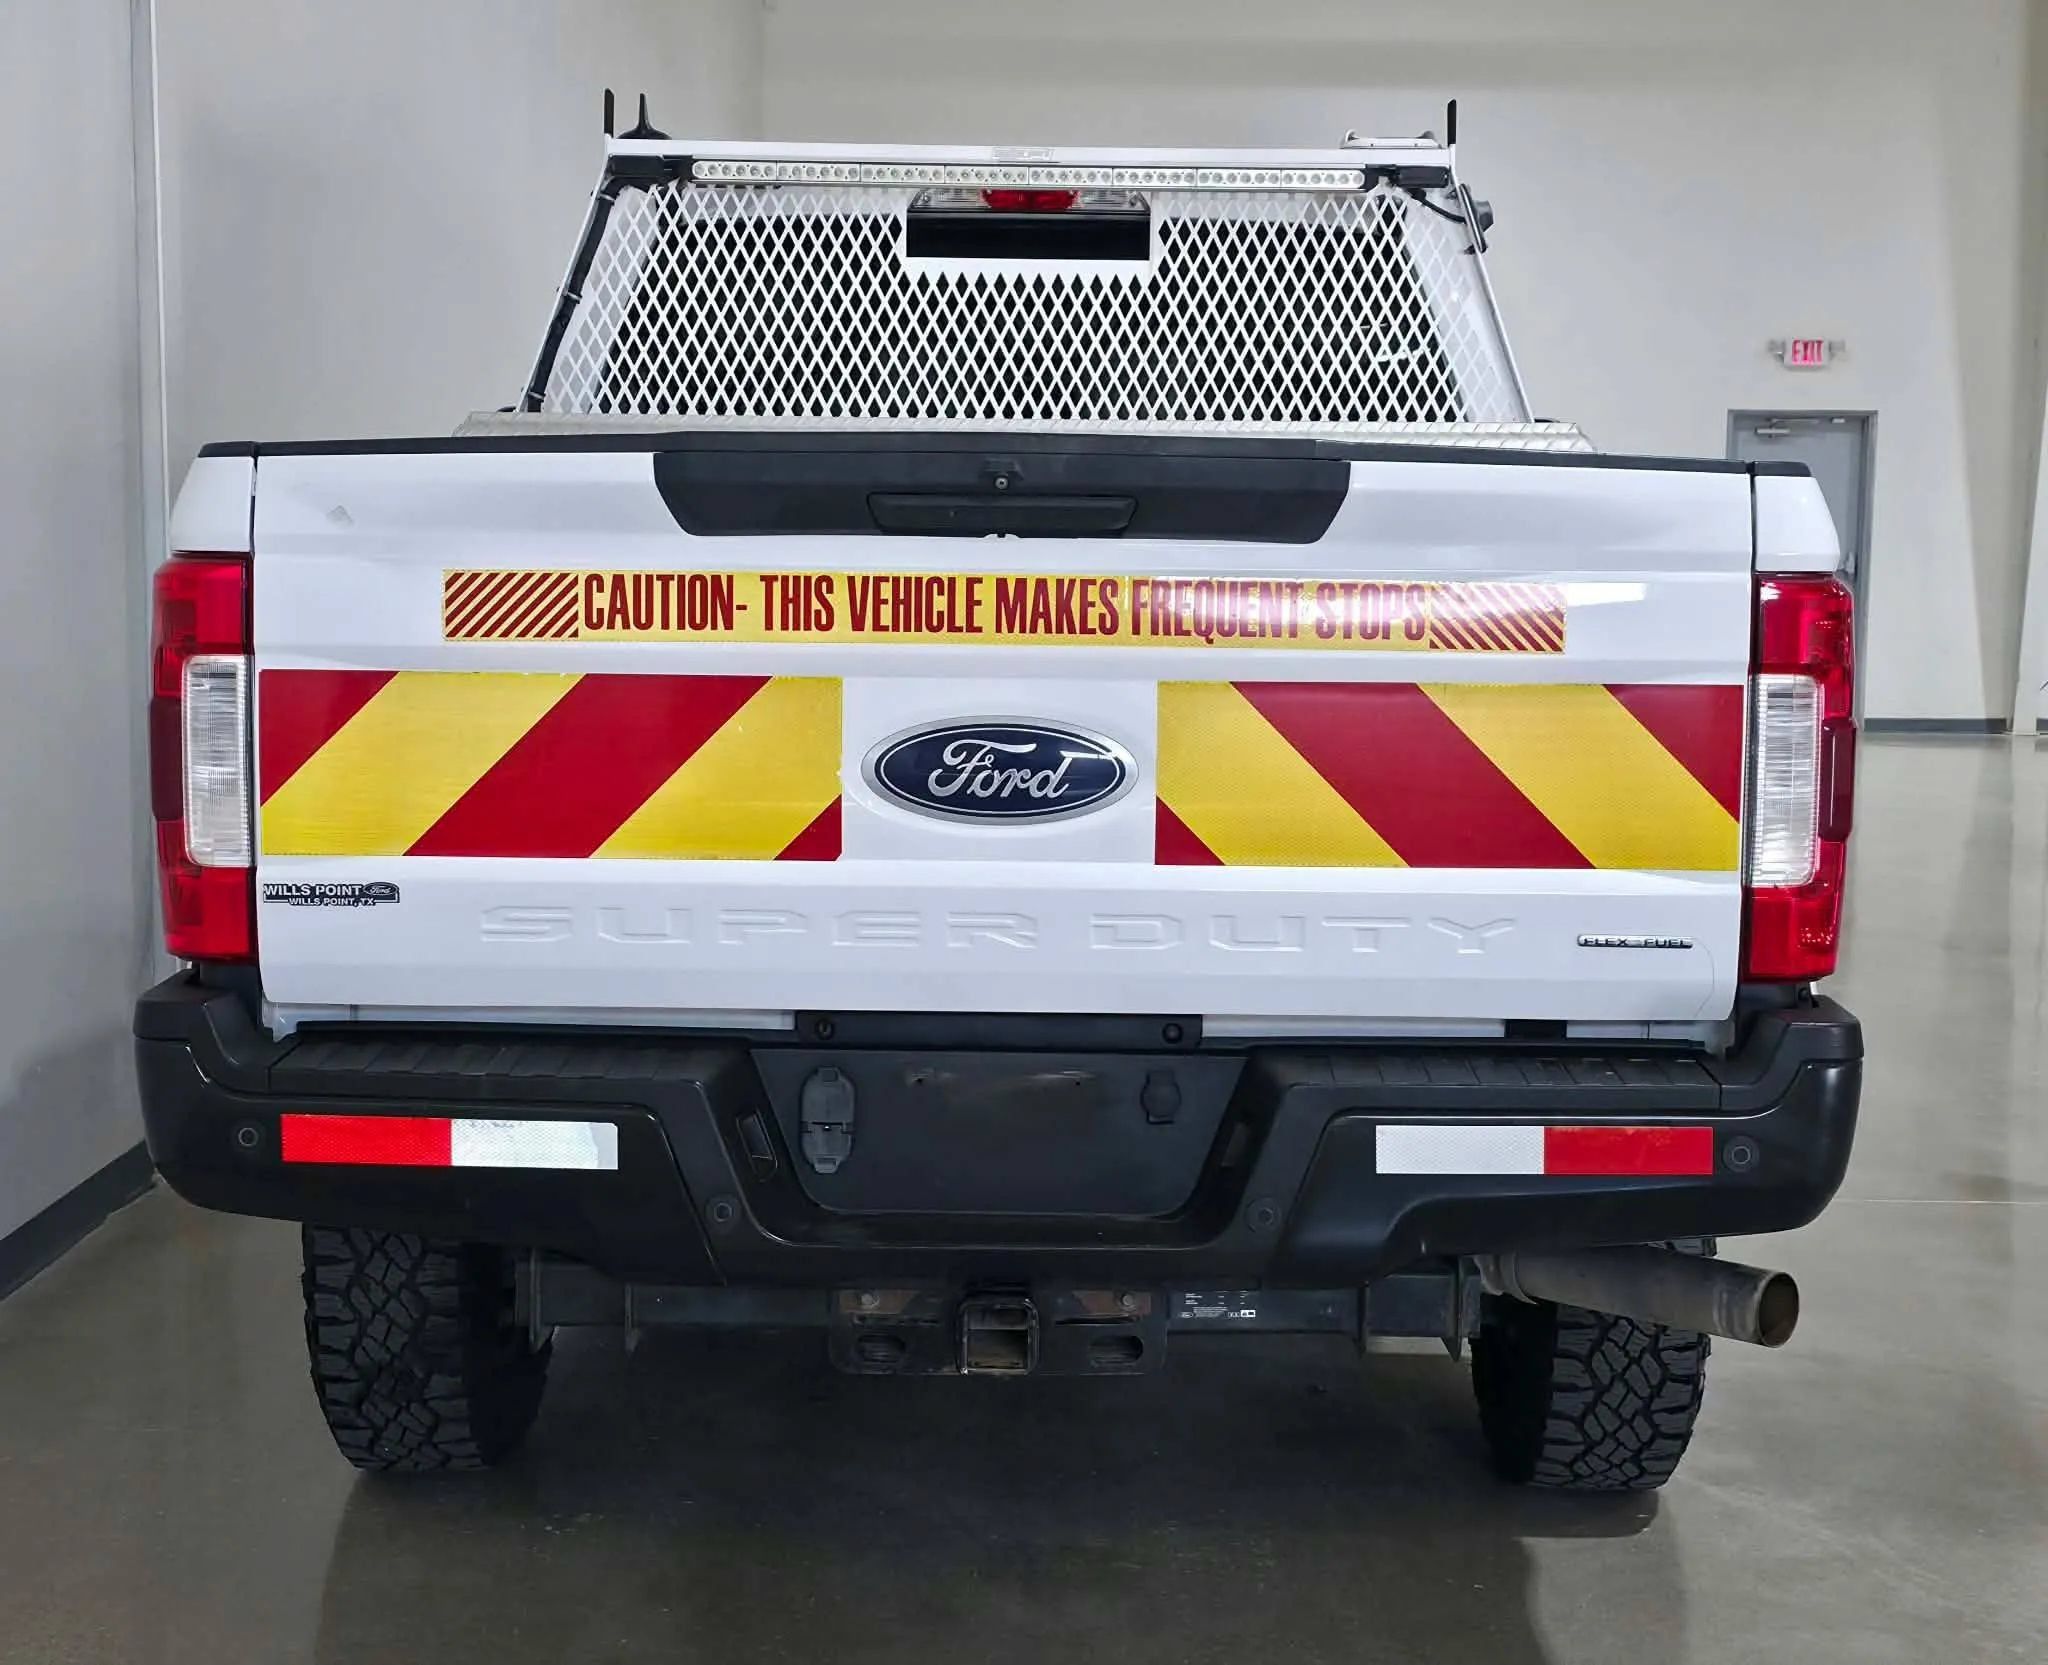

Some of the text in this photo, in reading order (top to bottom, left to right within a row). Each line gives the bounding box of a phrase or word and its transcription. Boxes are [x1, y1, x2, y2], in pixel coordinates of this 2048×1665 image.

[1791, 339, 1824, 366] EXIT
[584, 573, 1425, 644] CAUTION- THIS VEHICLE MAKES FREQUENT STOPS
[927, 739, 1070, 798] Ford
[264, 884, 362, 896] WILLS POINT
[288, 897, 320, 906] WILLS
[360, 897, 374, 906] TX
[480, 906, 1518, 954] SUPER DUTY
[1584, 937, 1692, 948] FLEX FUEL
